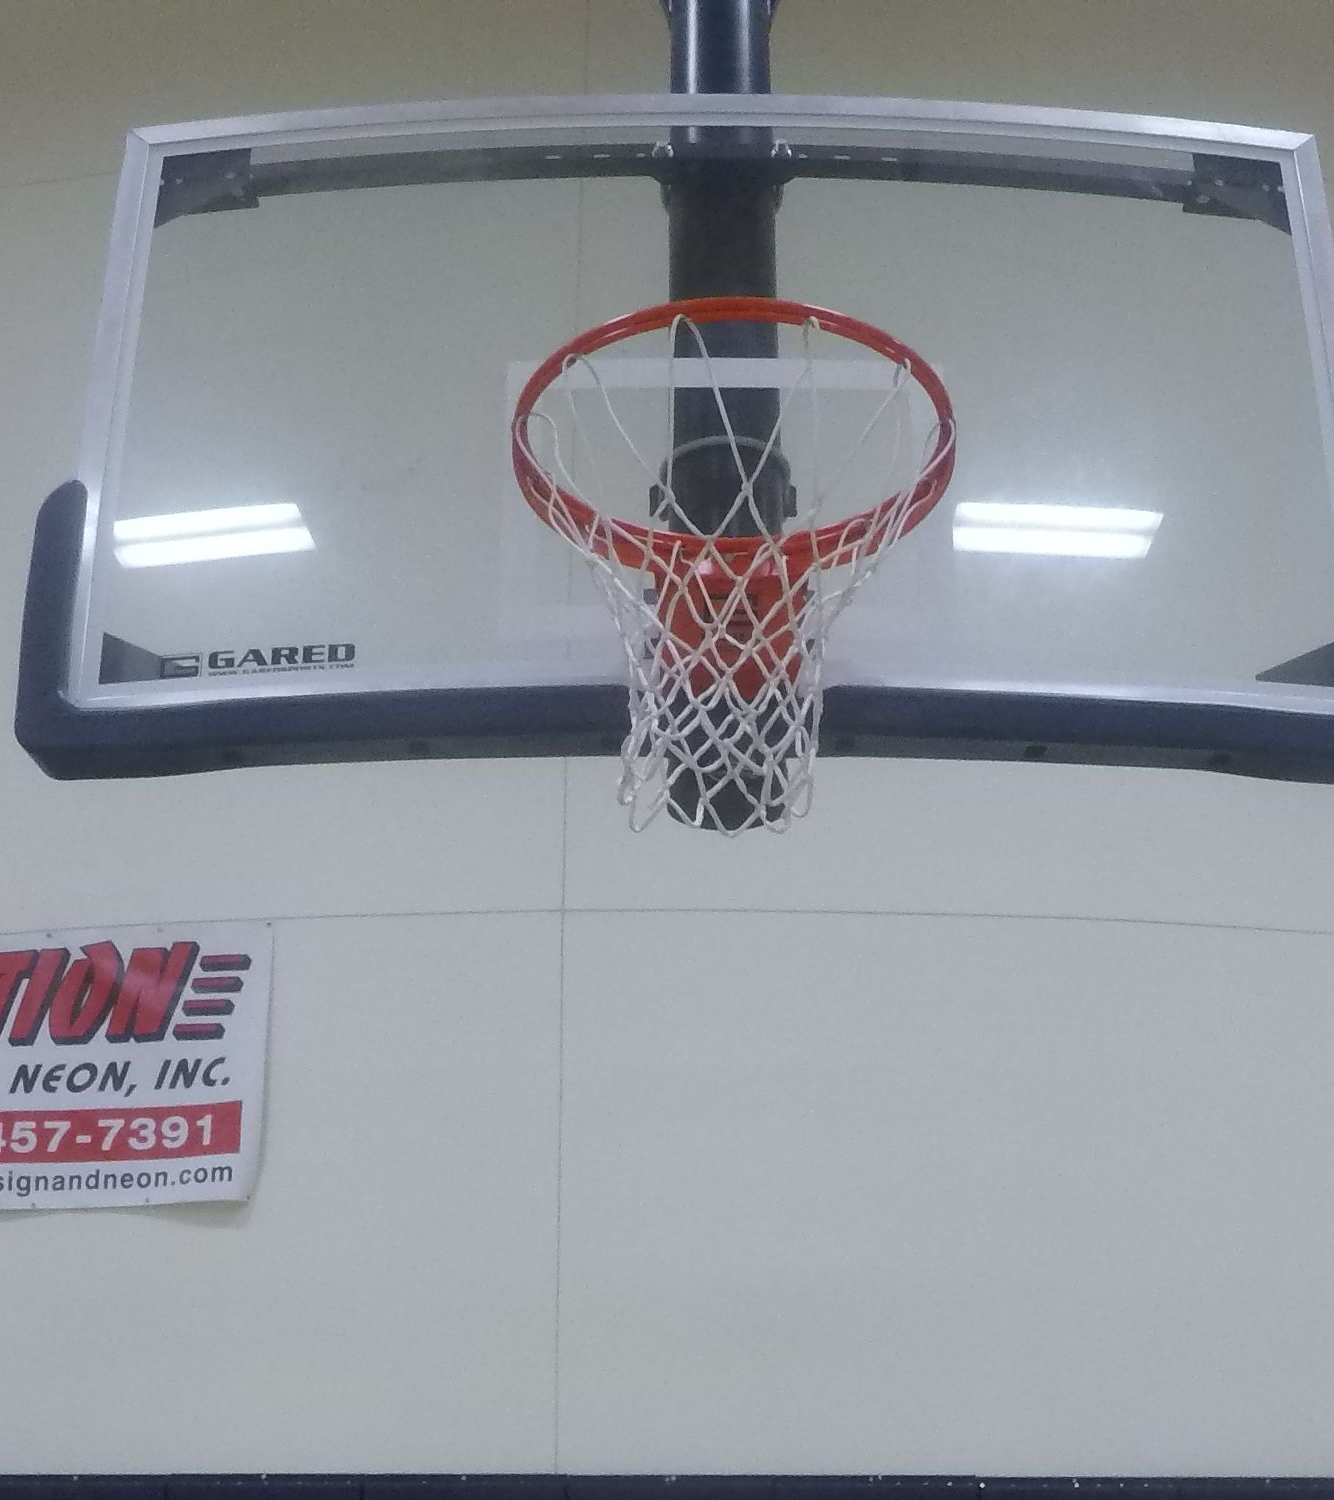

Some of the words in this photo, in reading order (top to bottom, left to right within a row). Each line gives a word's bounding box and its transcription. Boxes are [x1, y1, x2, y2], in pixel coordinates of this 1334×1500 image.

[208, 643, 355, 669] GARED
[10, 1061, 137, 1098] NEON,
[155, 1057, 231, 1091] INC.
